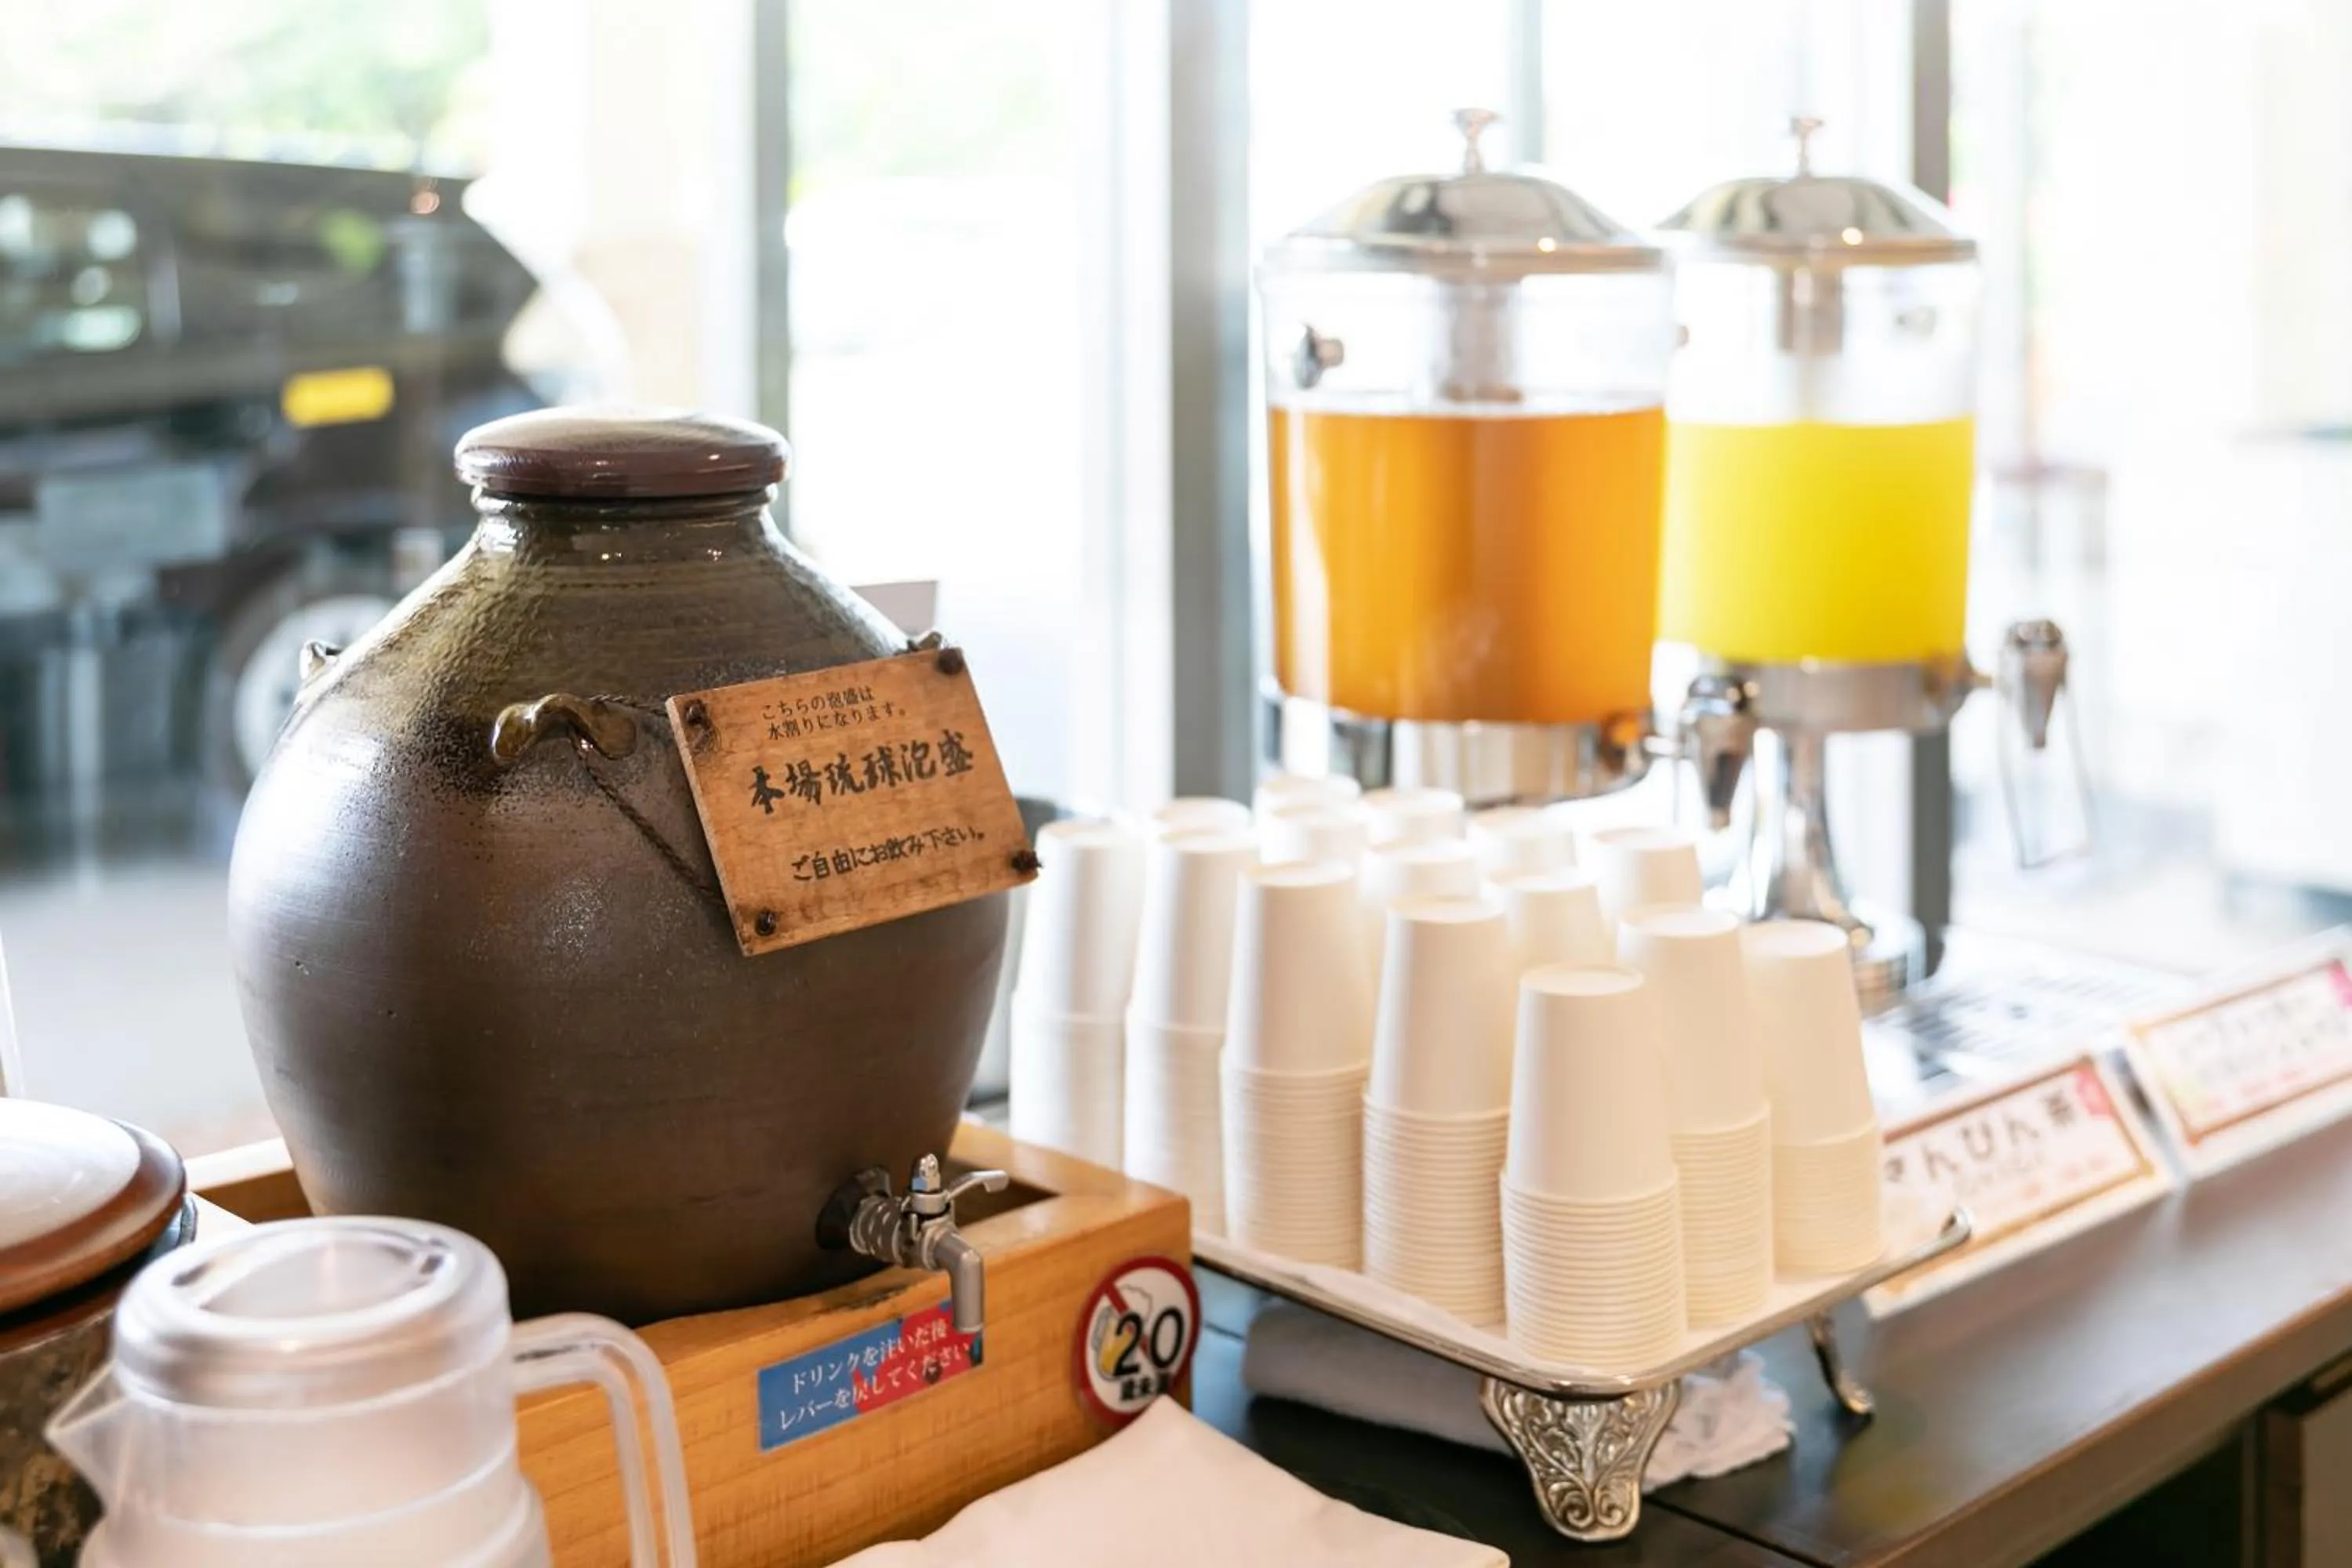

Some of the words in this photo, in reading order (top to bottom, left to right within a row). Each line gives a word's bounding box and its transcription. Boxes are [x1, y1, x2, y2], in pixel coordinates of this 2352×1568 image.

[768, 700, 906, 741] 水割りになります。
[750, 728, 975, 815] 本場琉球泡盛
[791, 826, 985, 882] ご自由にお飲み下さい。
[1112, 1305, 1185, 1377] 20
